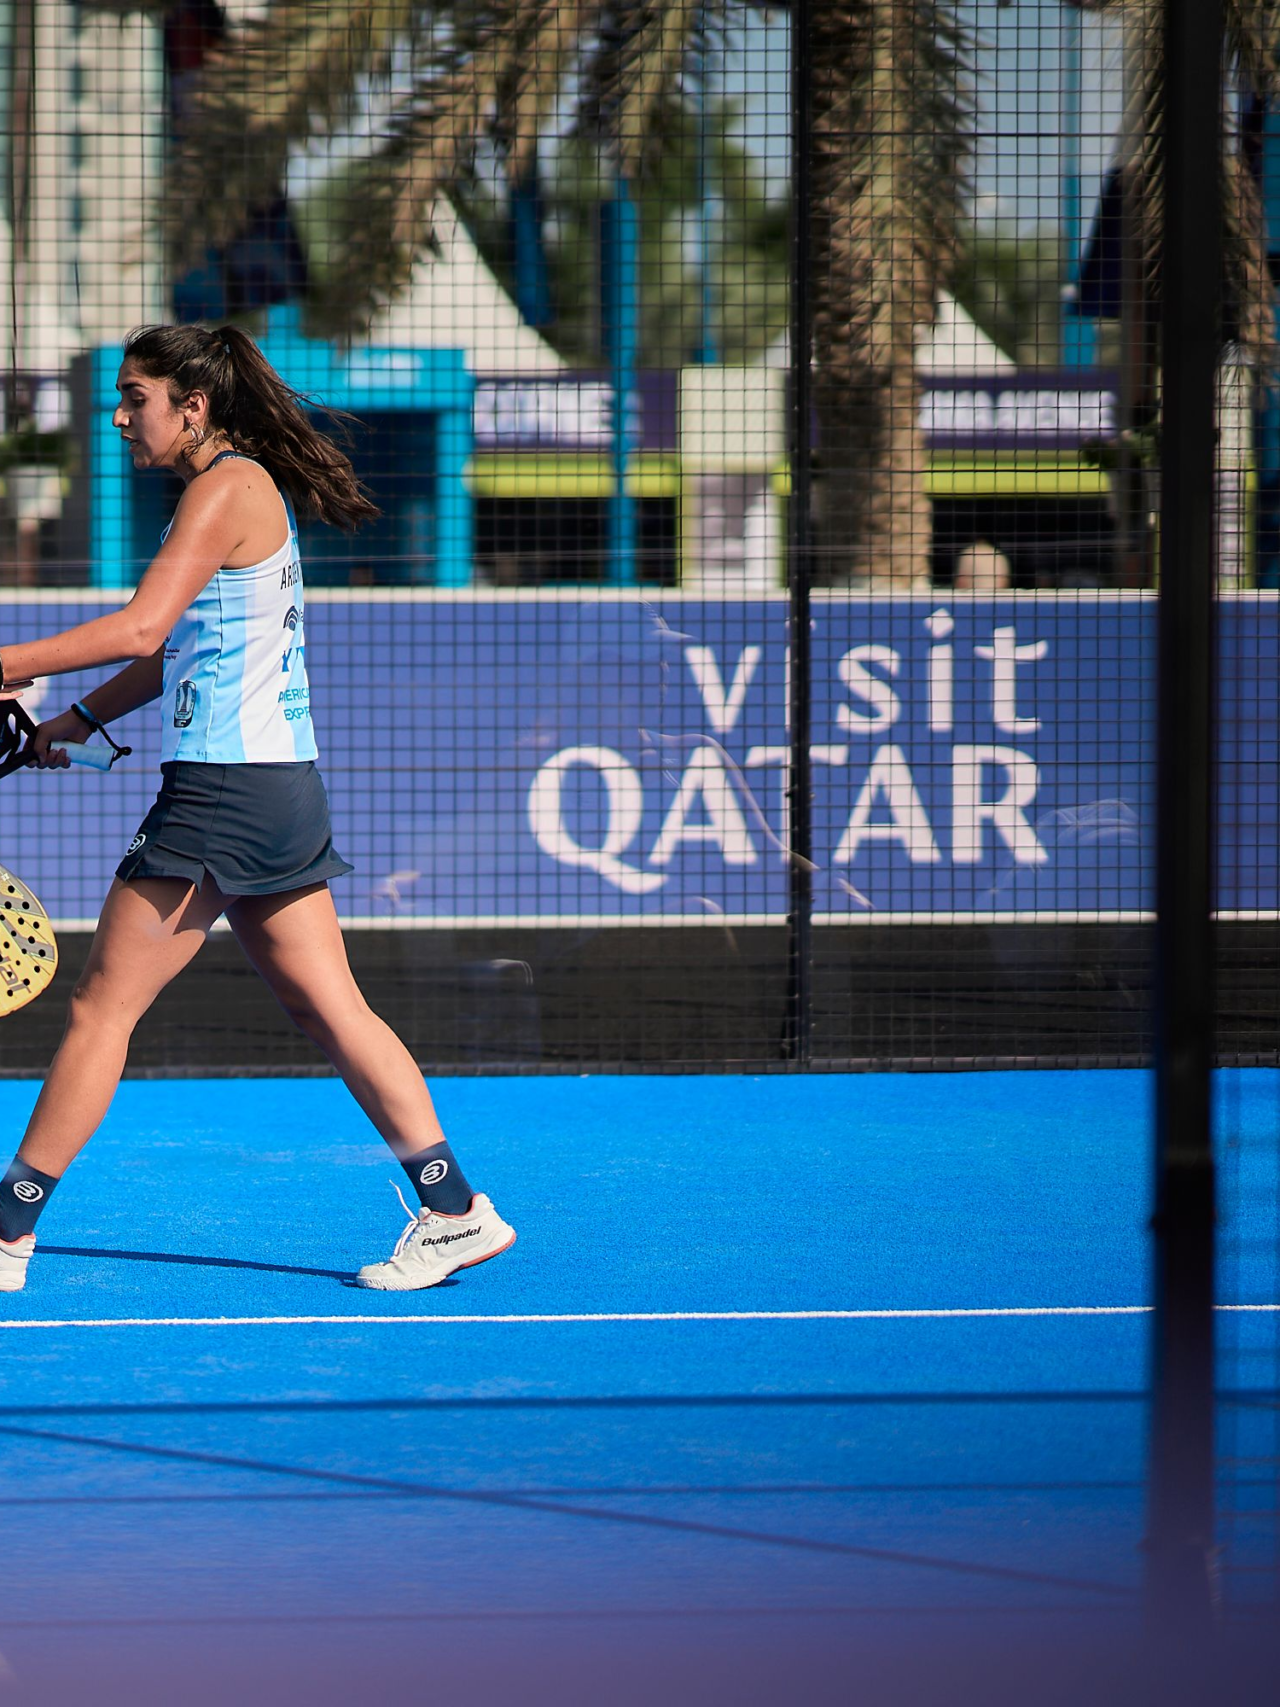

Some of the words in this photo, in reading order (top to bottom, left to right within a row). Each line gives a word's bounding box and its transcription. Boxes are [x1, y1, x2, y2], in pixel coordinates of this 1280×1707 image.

[684, 608, 1048, 733] vsit
[528, 744, 1049, 894] QATAR
[421, 1226, 482, 1247] Bullpadel
